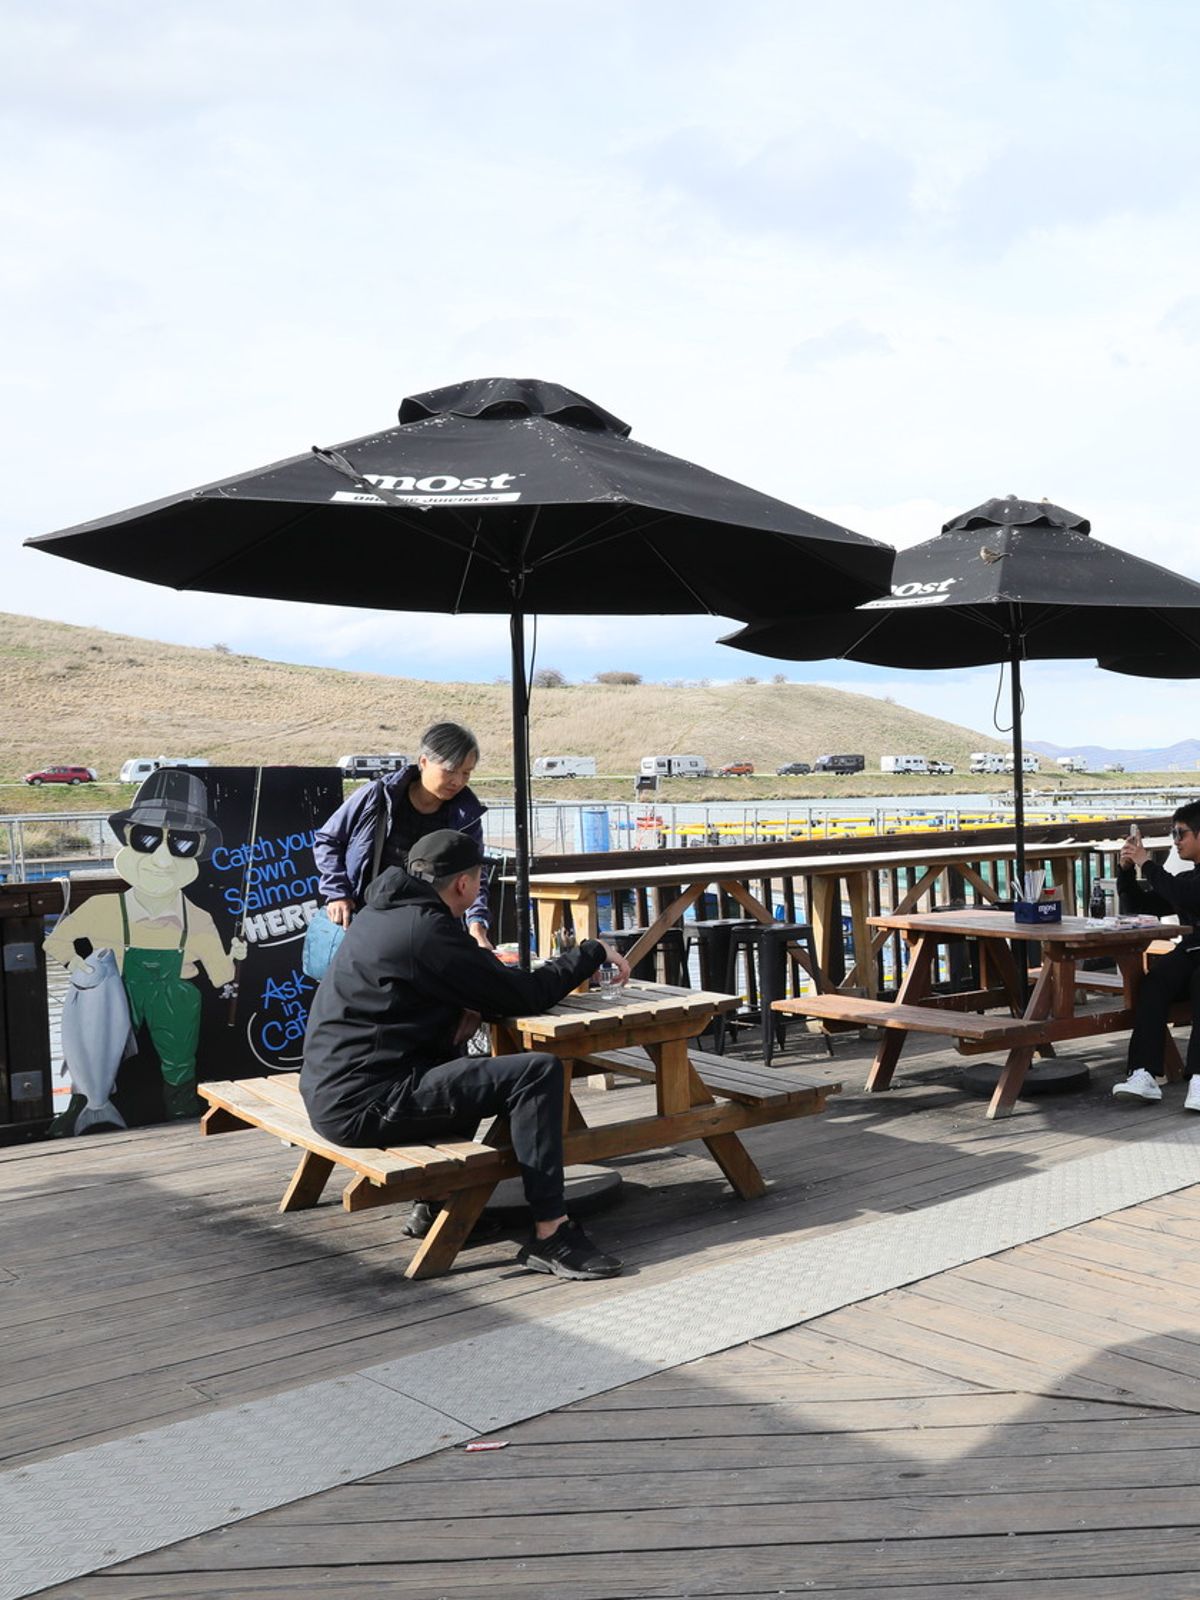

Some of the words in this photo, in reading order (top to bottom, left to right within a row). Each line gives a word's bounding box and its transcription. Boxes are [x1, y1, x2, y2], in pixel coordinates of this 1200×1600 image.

[211, 836, 276, 871] Catch
[245, 859, 297, 885] own
[224, 875, 320, 915] Salmon
[261, 969, 314, 1009] Ask
[281, 1001, 303, 1017] in
[262, 1009, 308, 1051] Caf
